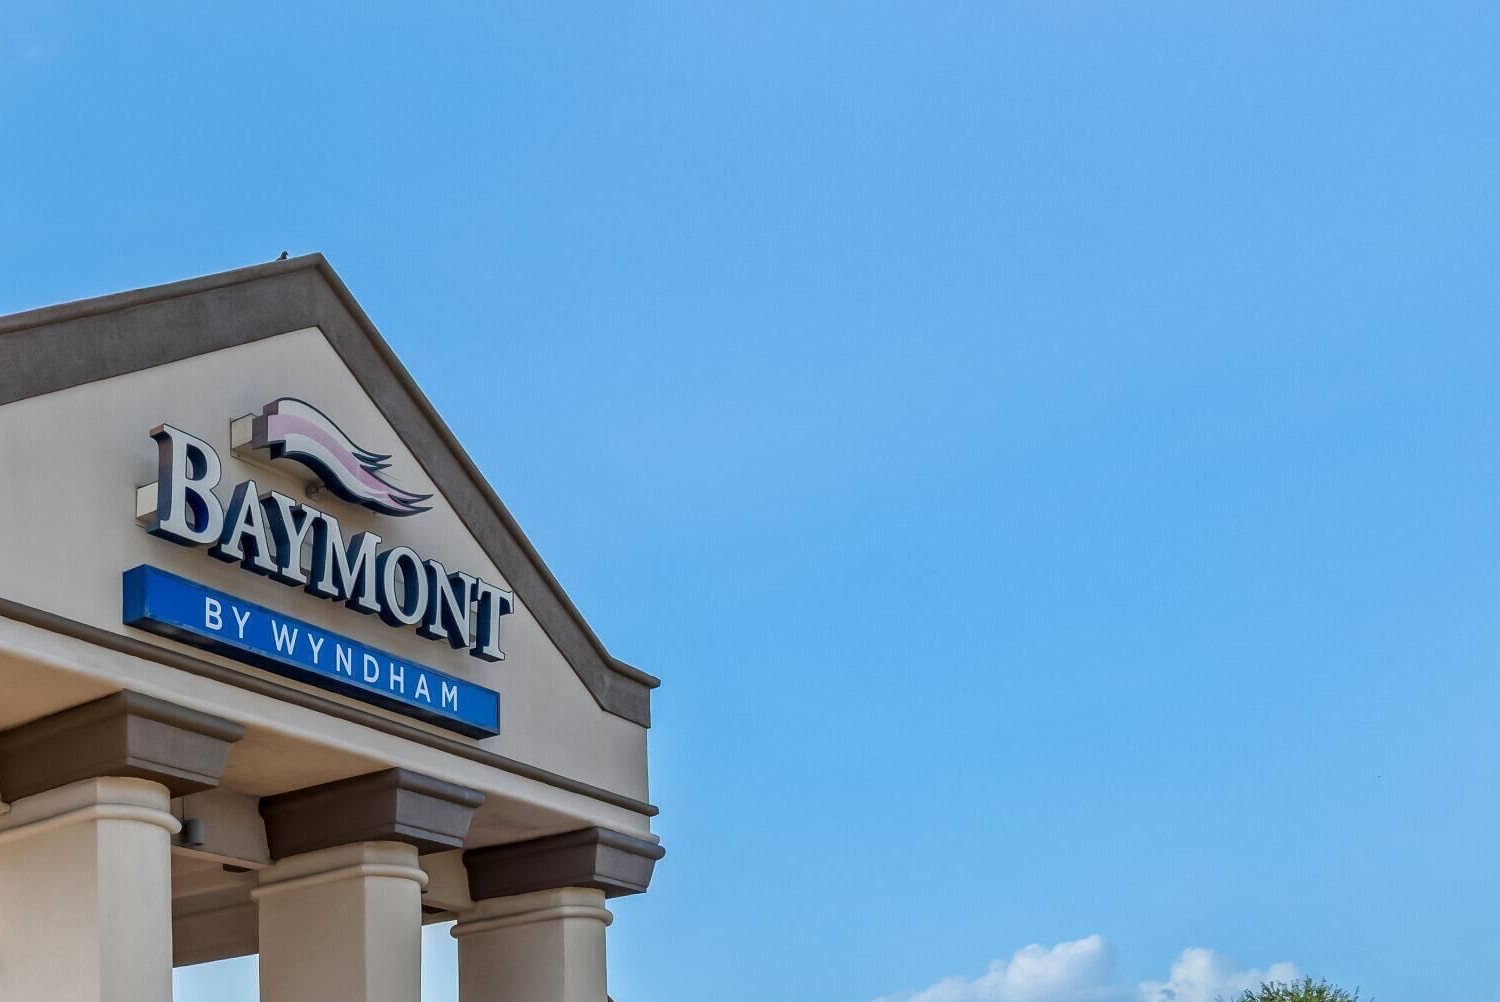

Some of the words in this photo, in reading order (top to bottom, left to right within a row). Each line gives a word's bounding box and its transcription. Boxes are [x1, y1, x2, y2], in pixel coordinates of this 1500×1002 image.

[150, 423, 514, 662] BAYMONT
[204, 596, 251, 639] BY
[271, 619, 459, 712] WYNDHAM
